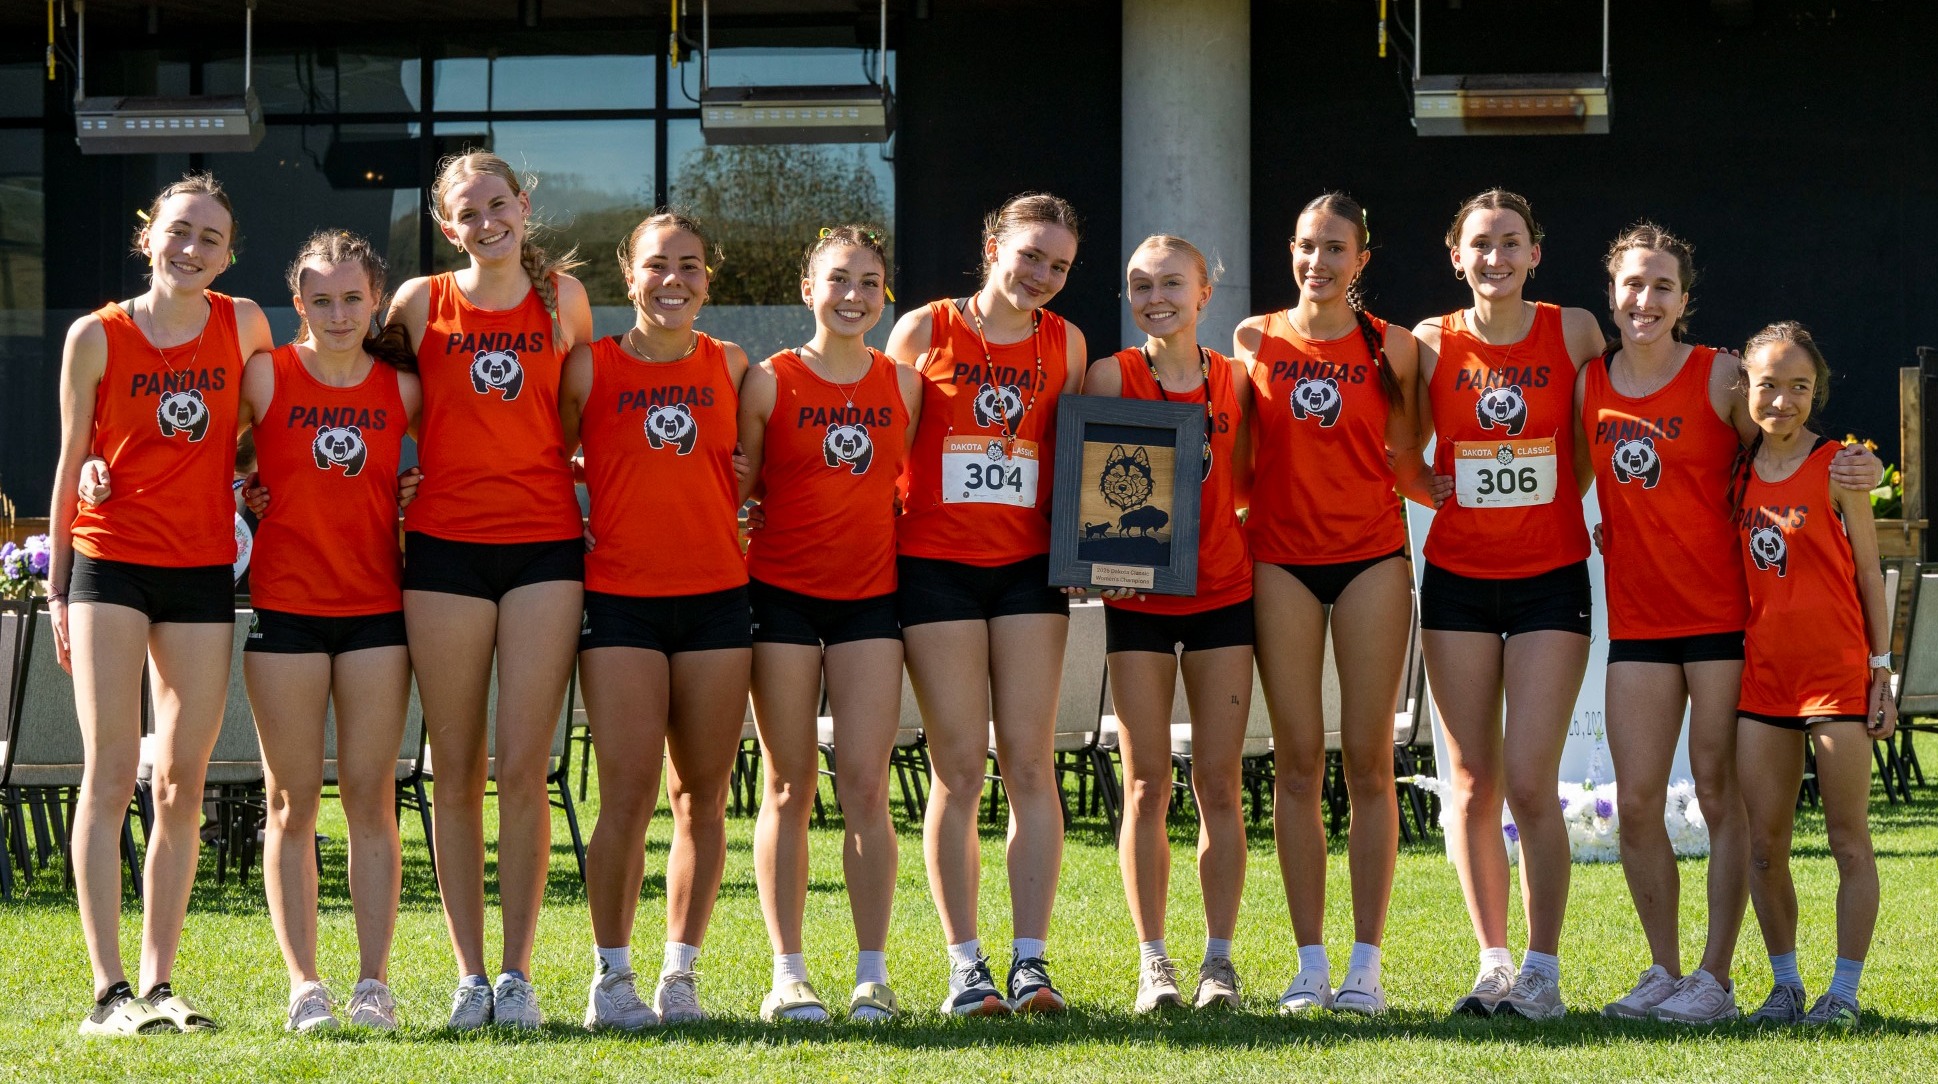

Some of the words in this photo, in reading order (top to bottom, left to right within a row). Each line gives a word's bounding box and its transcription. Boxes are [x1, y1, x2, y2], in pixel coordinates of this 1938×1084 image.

[446, 332, 544, 354] PANDAS
[131, 367, 226, 397] PANDAS
[1271, 361, 1368, 384] PANDAS
[1455, 366, 1550, 391] PANDAS
[617, 385, 715, 413] PANDAS
[287, 406, 387, 430] PANDAS
[798, 407, 893, 429] PANDAS
[1595, 417, 1683, 445] PANDAS
[950, 443, 983, 451] DAKOTA
[1012, 446, 1034, 457] LASSIC
[1462, 449, 1493, 457] DAKOTA
[1517, 446, 1551, 455] CLASSIC
[964, 463, 1023, 493] 304
[1476, 467, 1538, 495] 306
[1737, 505, 1808, 530] PANDAS
